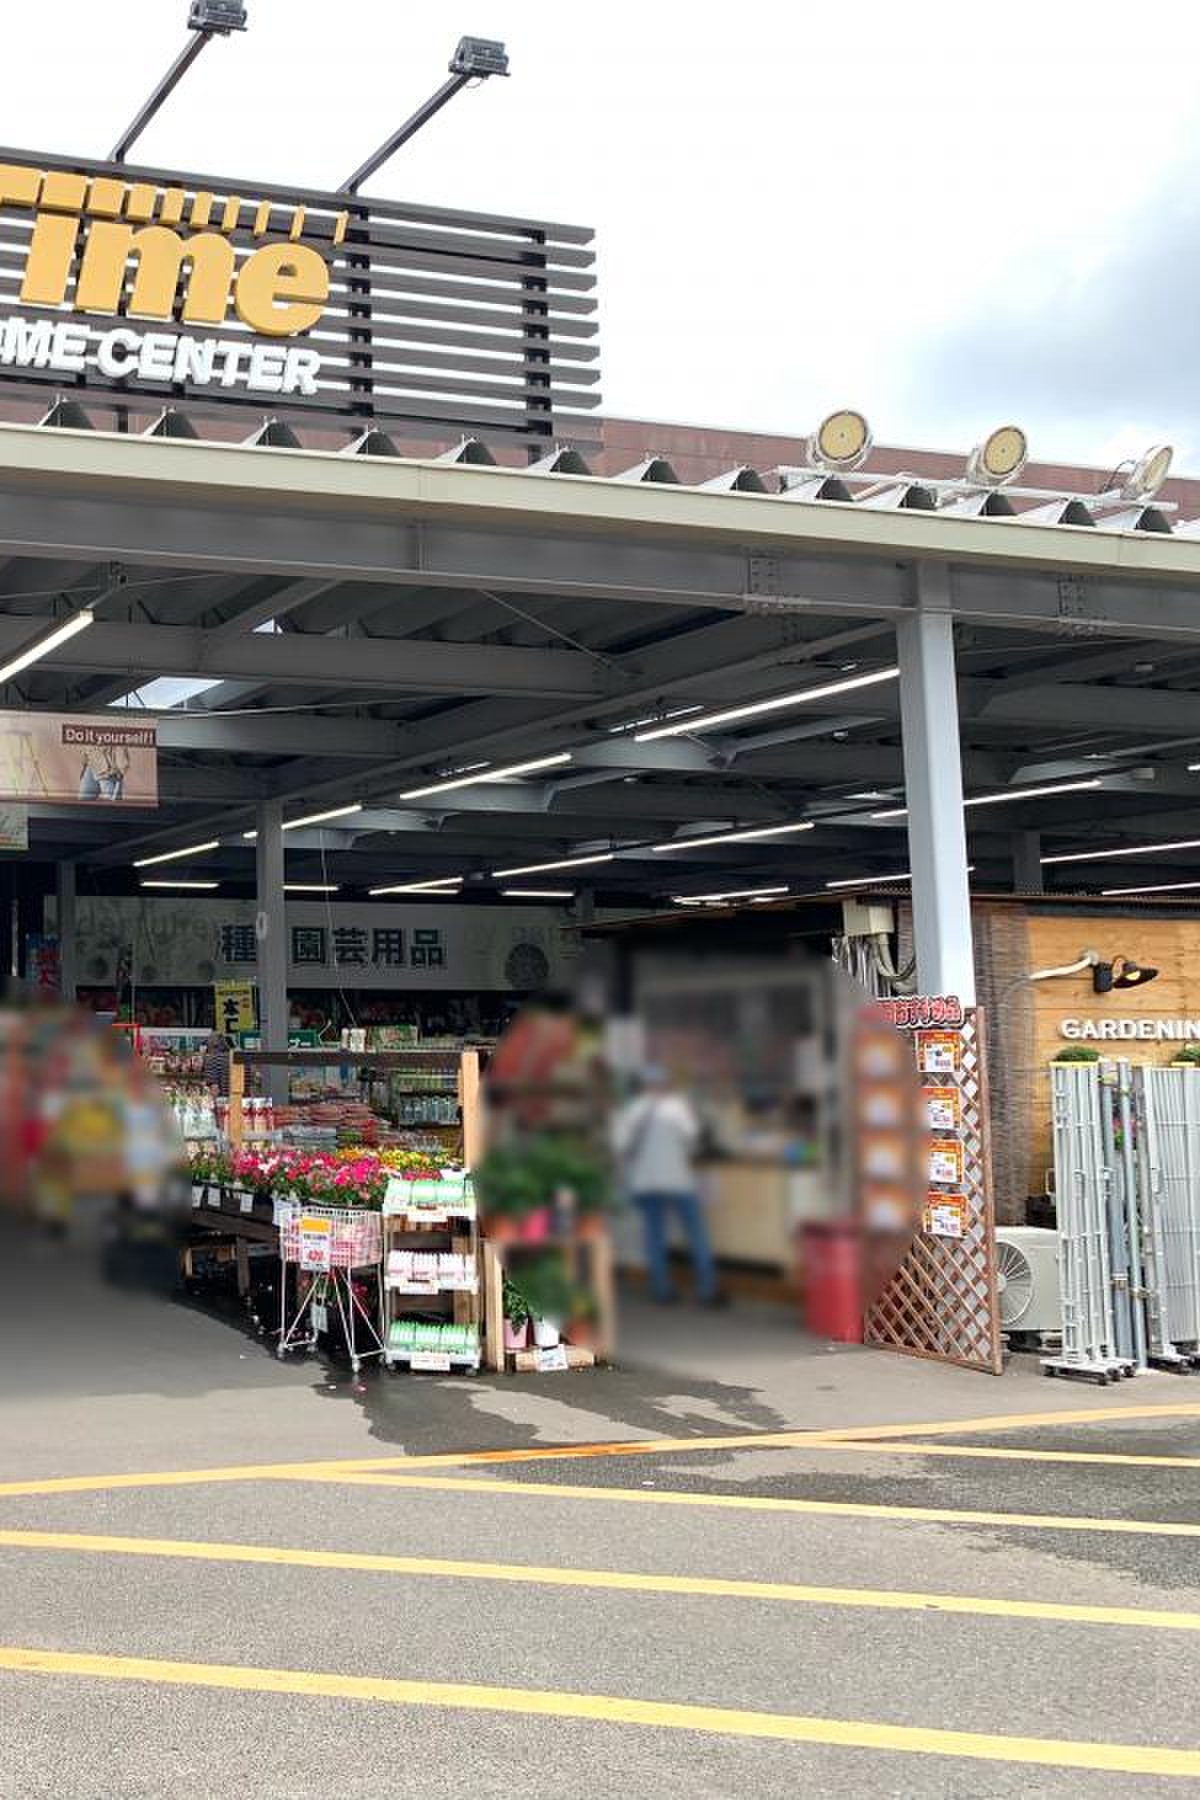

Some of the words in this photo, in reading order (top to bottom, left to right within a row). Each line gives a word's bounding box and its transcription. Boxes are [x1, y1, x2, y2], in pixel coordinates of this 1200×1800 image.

[97, 328, 322, 394] CENTER
[221, 925, 444, 965] 種園芸用品
[1061, 1018, 1200, 1040] GARDENIN
